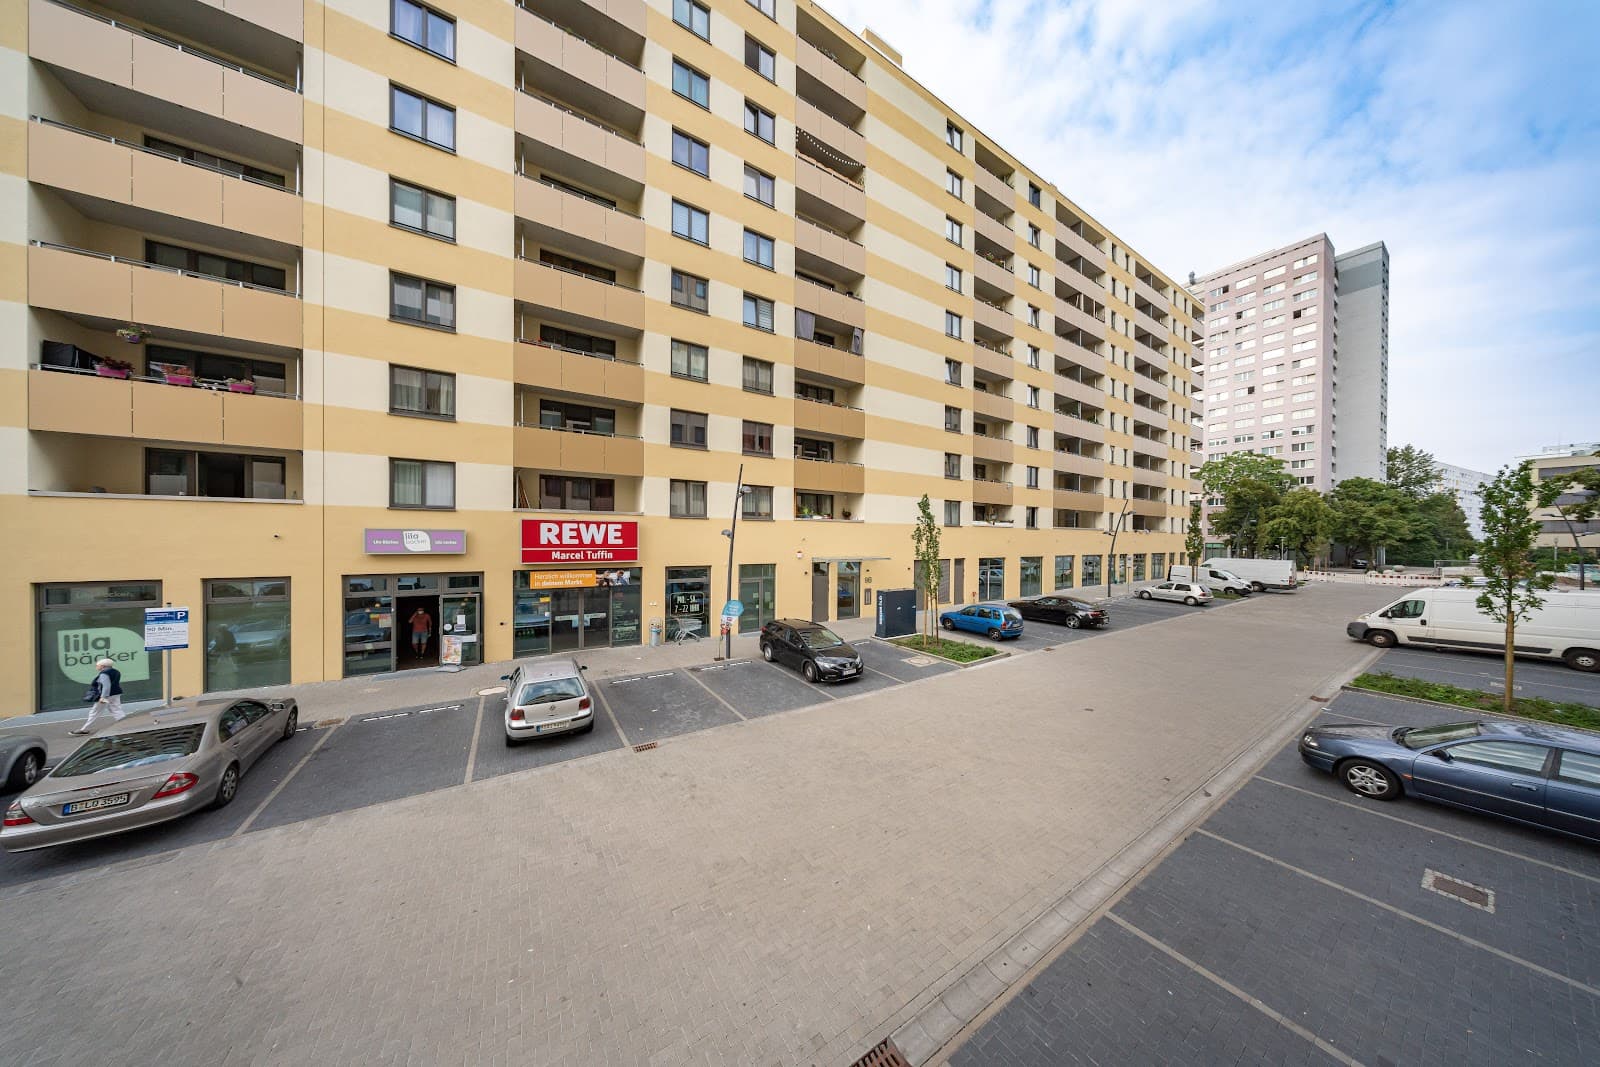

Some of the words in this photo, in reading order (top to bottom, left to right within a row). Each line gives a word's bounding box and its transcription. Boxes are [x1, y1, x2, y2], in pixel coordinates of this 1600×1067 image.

[540, 522, 623, 545] REWE
[551, 550, 584, 560] Marcel
[586, 550, 613, 560] Tuffin
[177, 611, 186, 620] P
[64, 633, 111, 652] lila
[64, 650, 138, 667] bäcker
